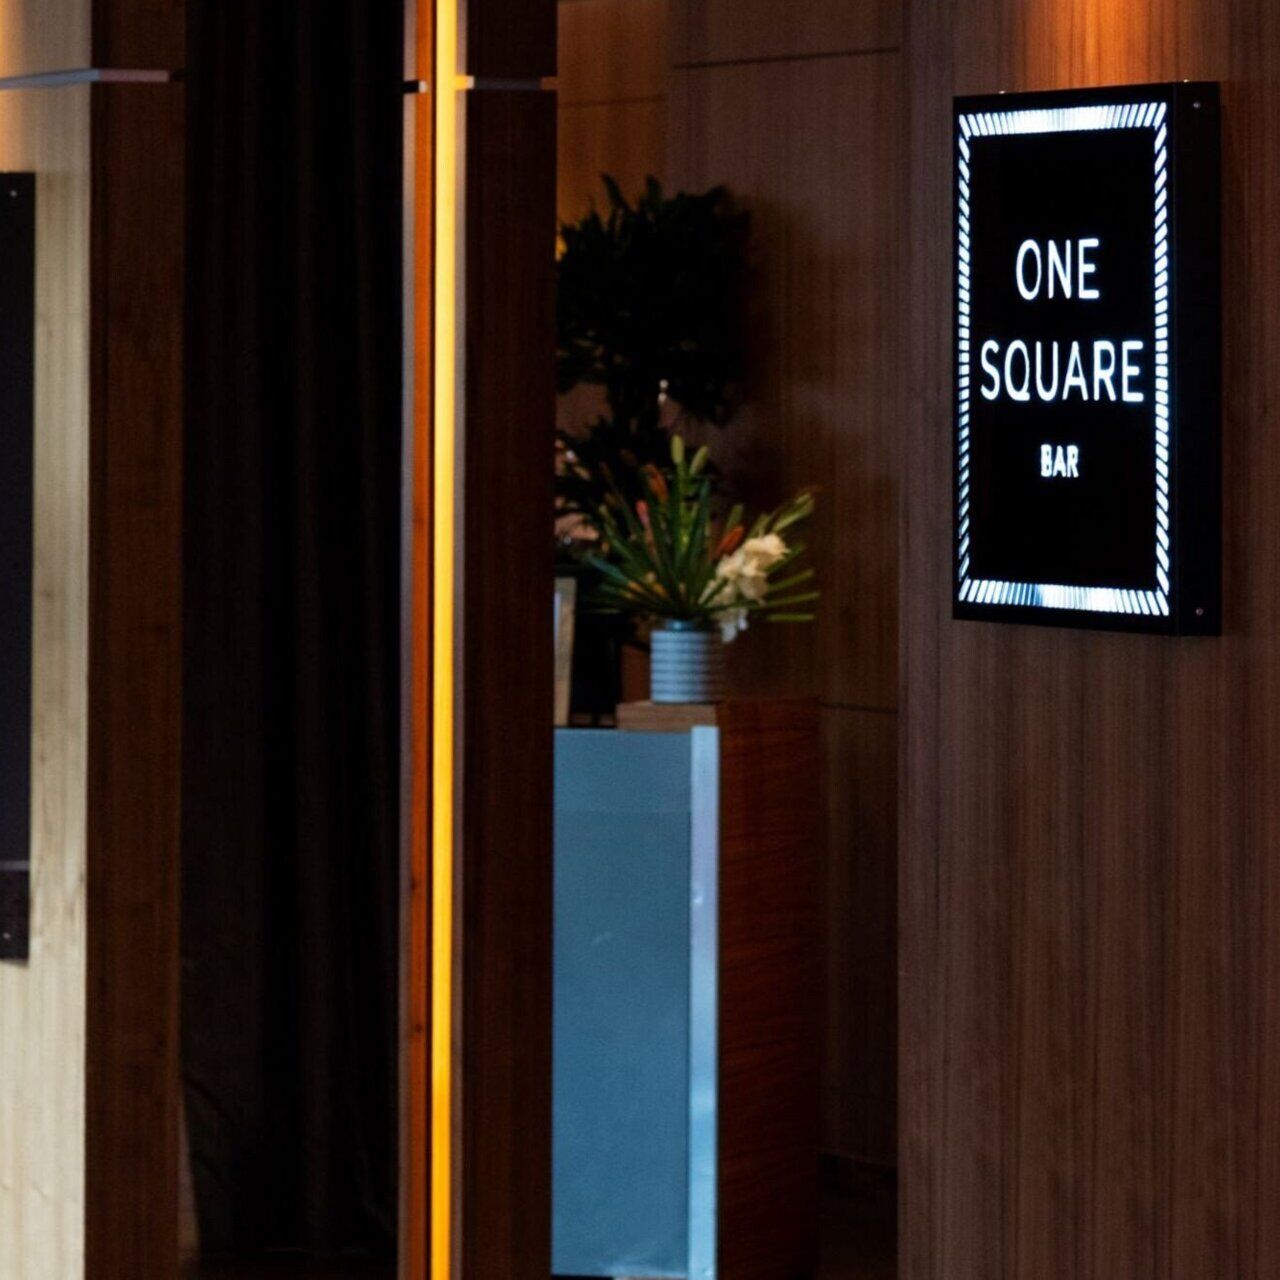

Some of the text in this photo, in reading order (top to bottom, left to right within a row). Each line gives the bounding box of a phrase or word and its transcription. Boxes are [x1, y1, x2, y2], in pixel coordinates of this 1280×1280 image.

[1016, 238, 1100, 301] ONE
[980, 340, 1145, 403] SQUARE
[1040, 444, 1079, 478] BAR
